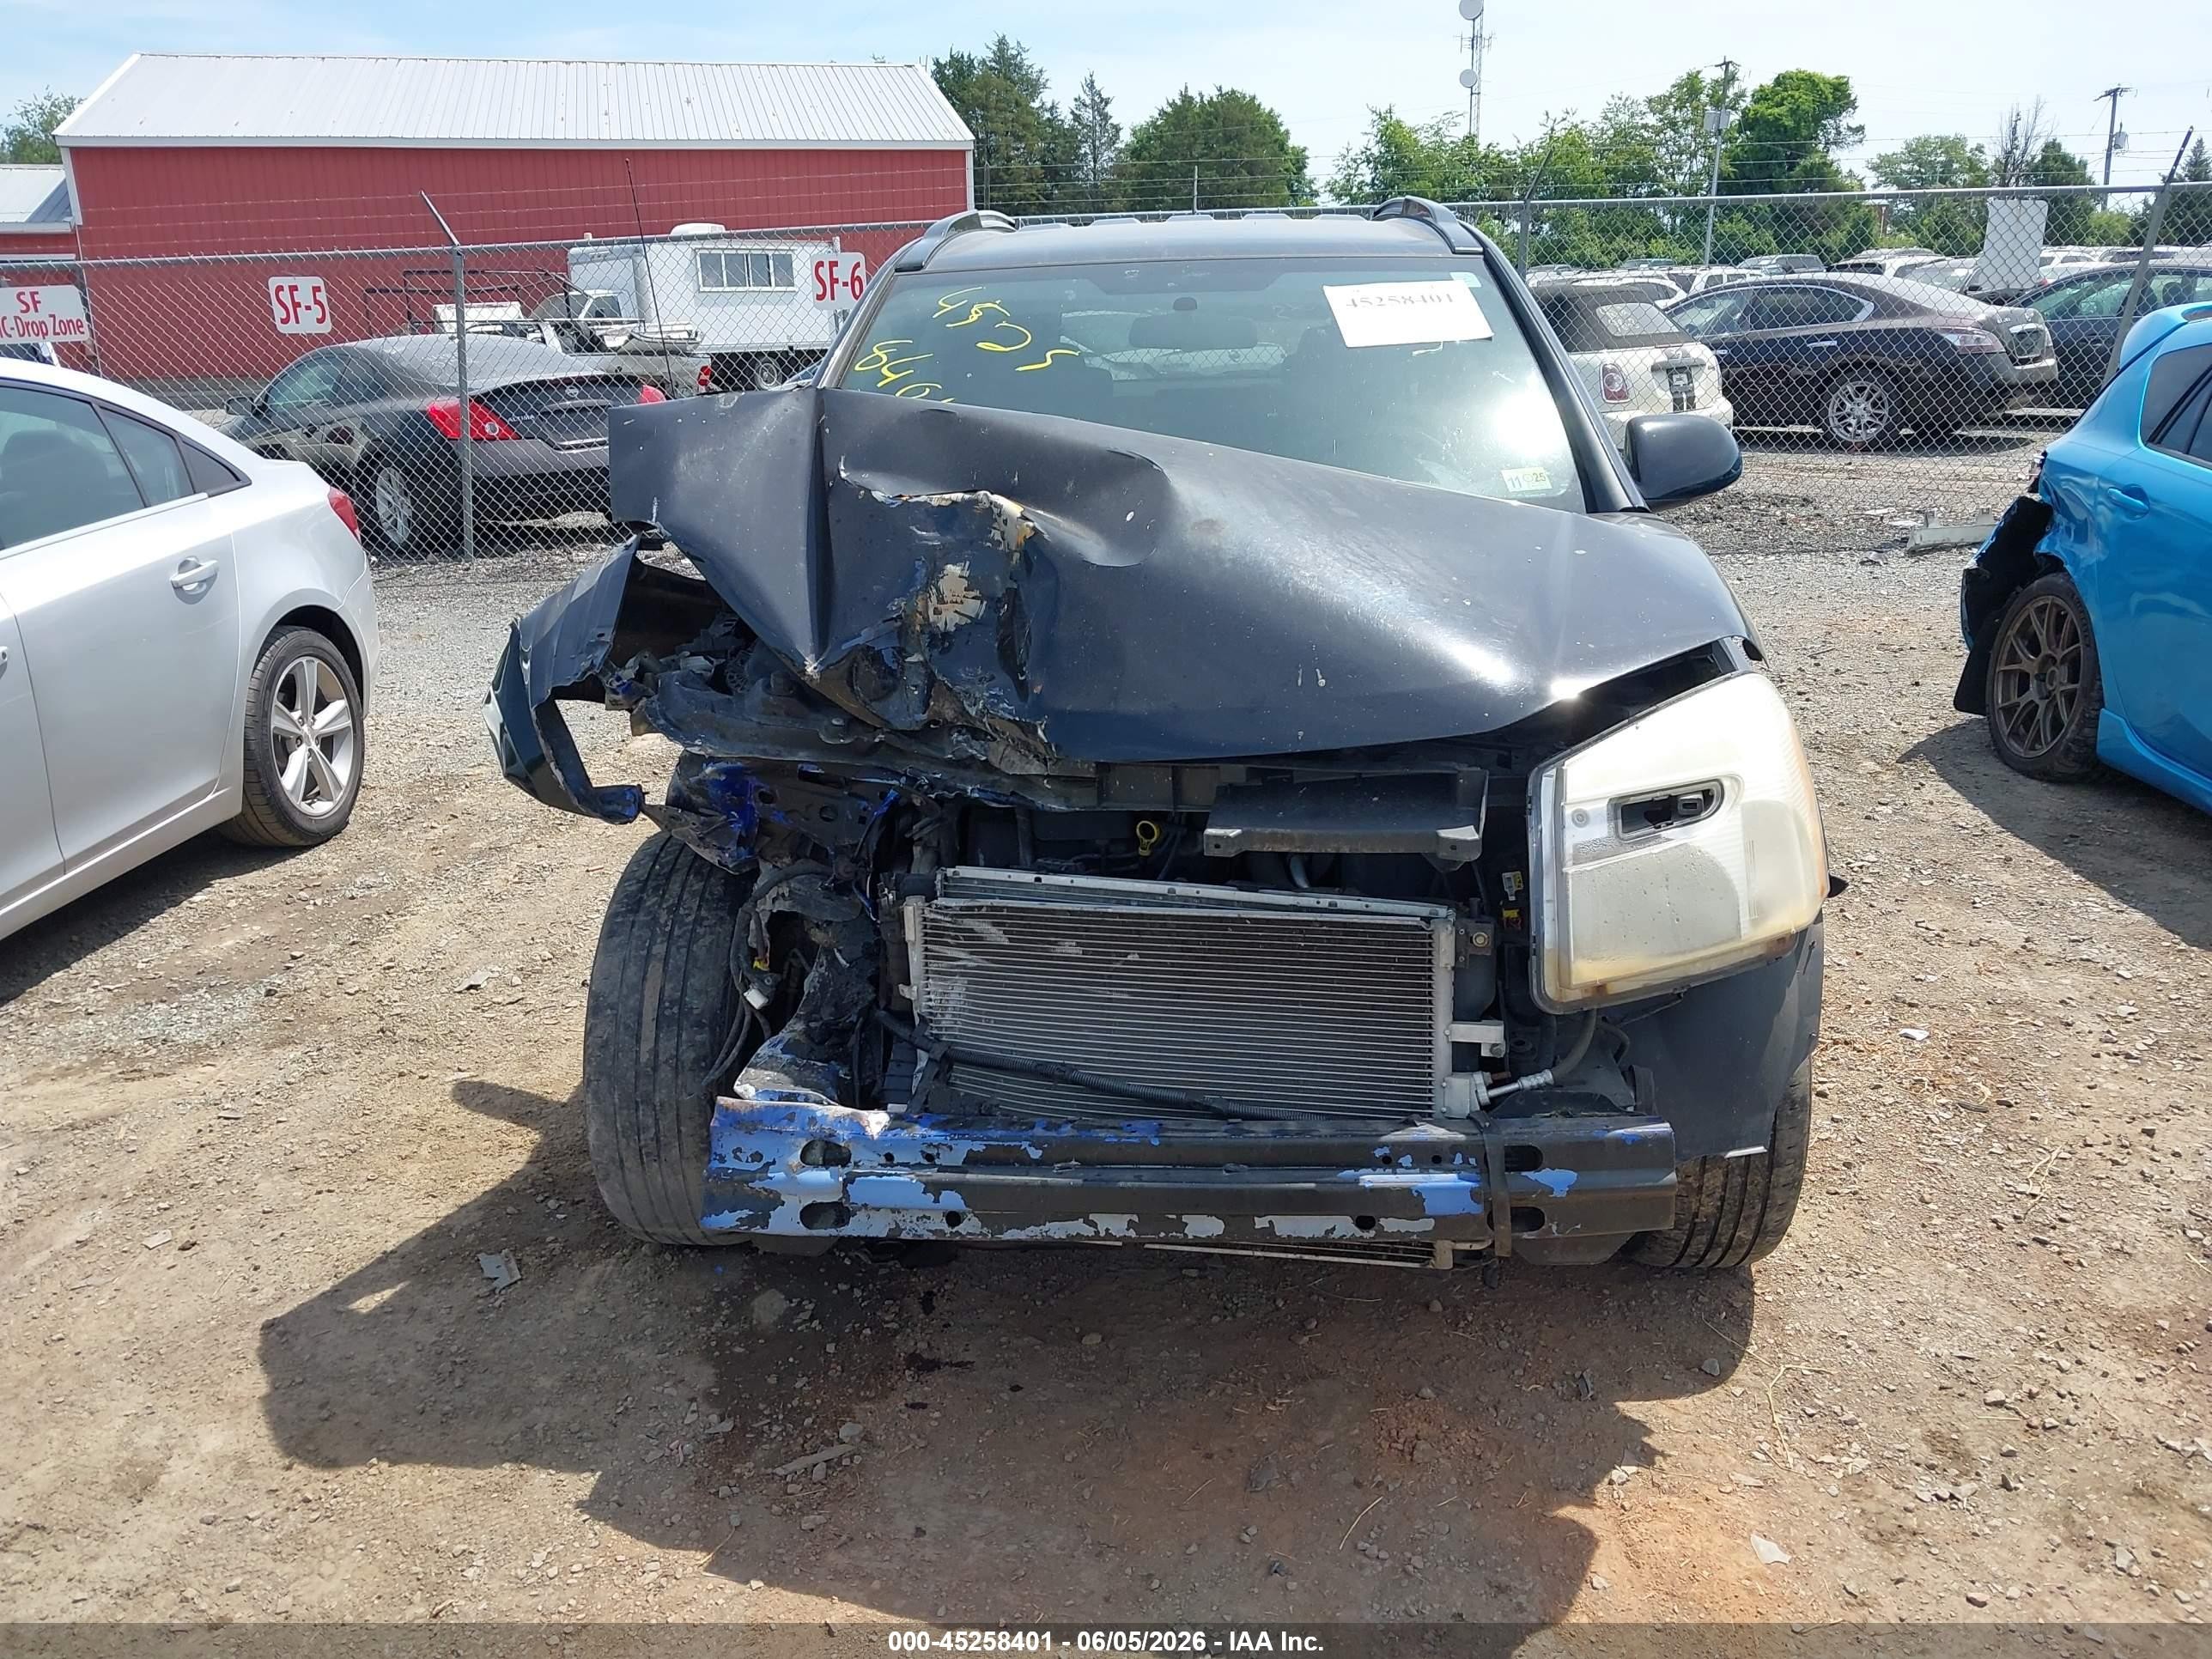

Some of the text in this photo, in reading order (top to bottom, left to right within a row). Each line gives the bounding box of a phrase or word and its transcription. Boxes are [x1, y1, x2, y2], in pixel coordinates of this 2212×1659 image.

[814, 260, 863, 301] SF-6
[15, 290, 41, 313] SF
[275, 284, 326, 325] SF-5
[0, 313, 85, 339] C-Drop Zone
[1533, 472, 1547, 483] 25
